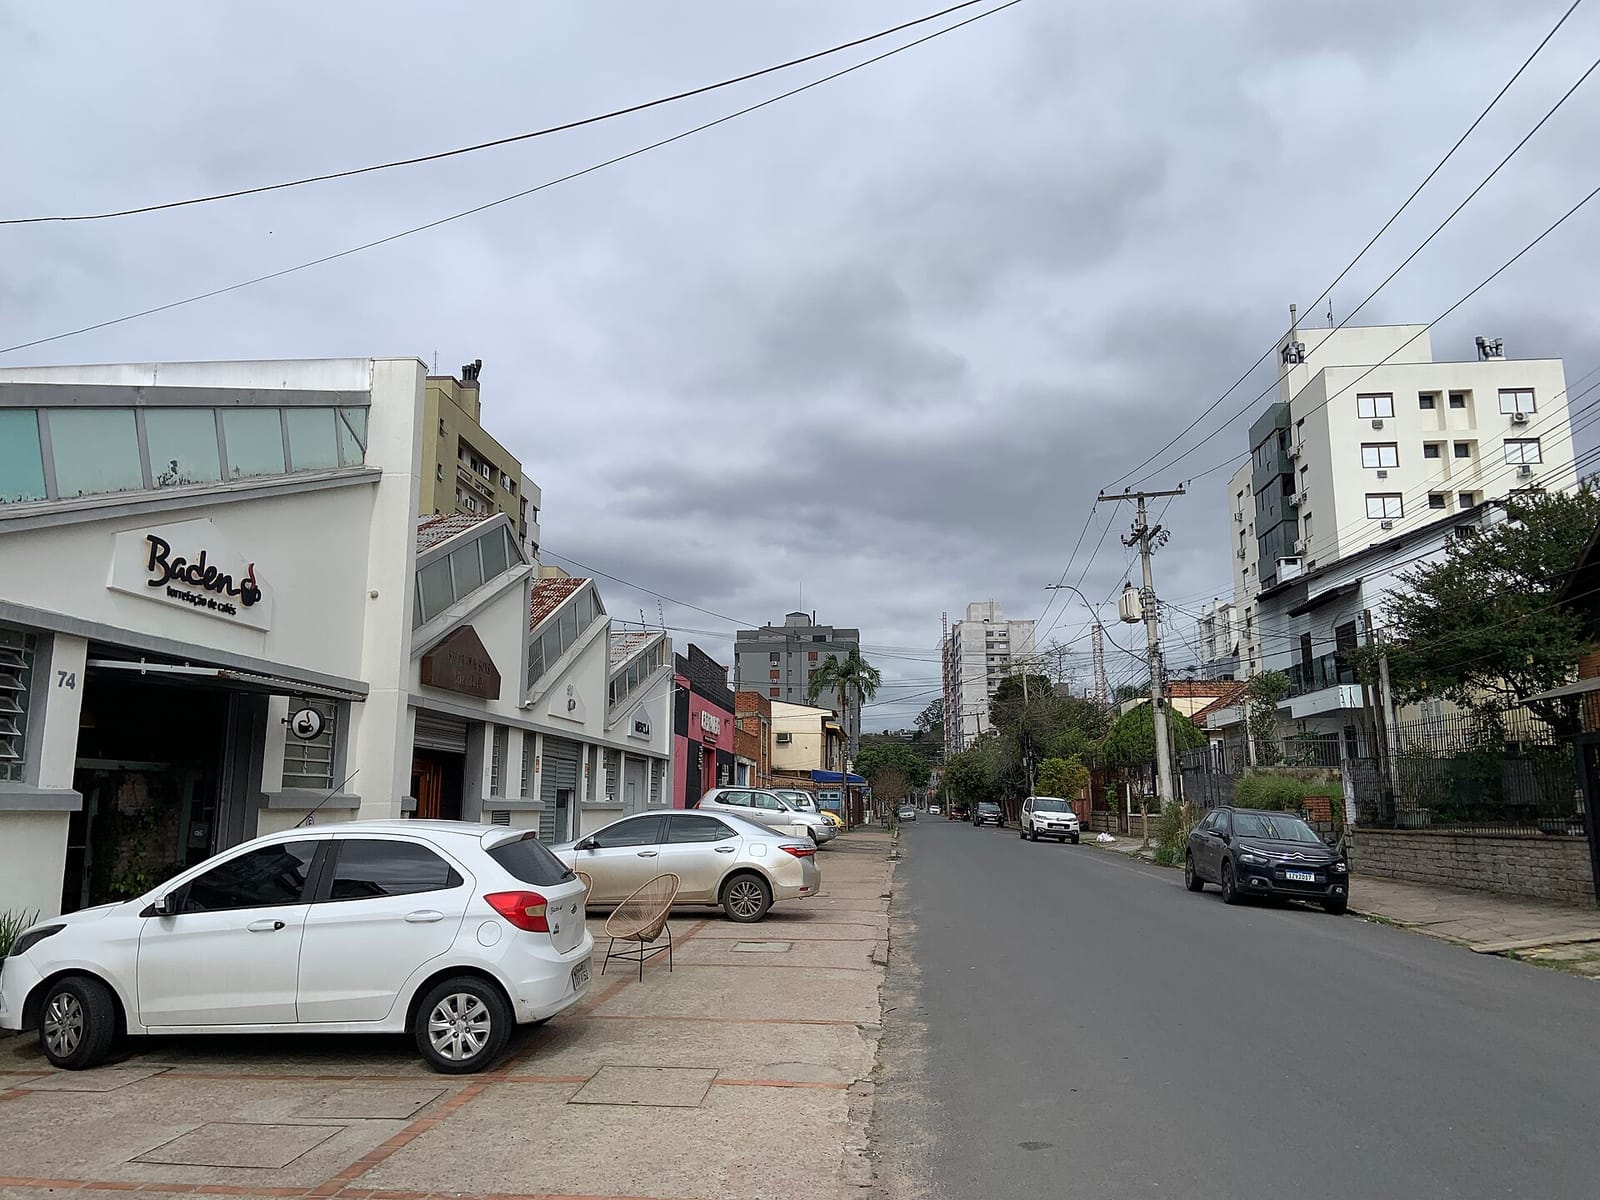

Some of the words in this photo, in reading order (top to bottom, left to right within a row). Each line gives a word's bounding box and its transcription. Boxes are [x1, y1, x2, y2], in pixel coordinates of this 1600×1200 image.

[146, 534, 241, 596] Baden
[207, 598, 218, 610] de
[58, 670, 75, 690] 74
